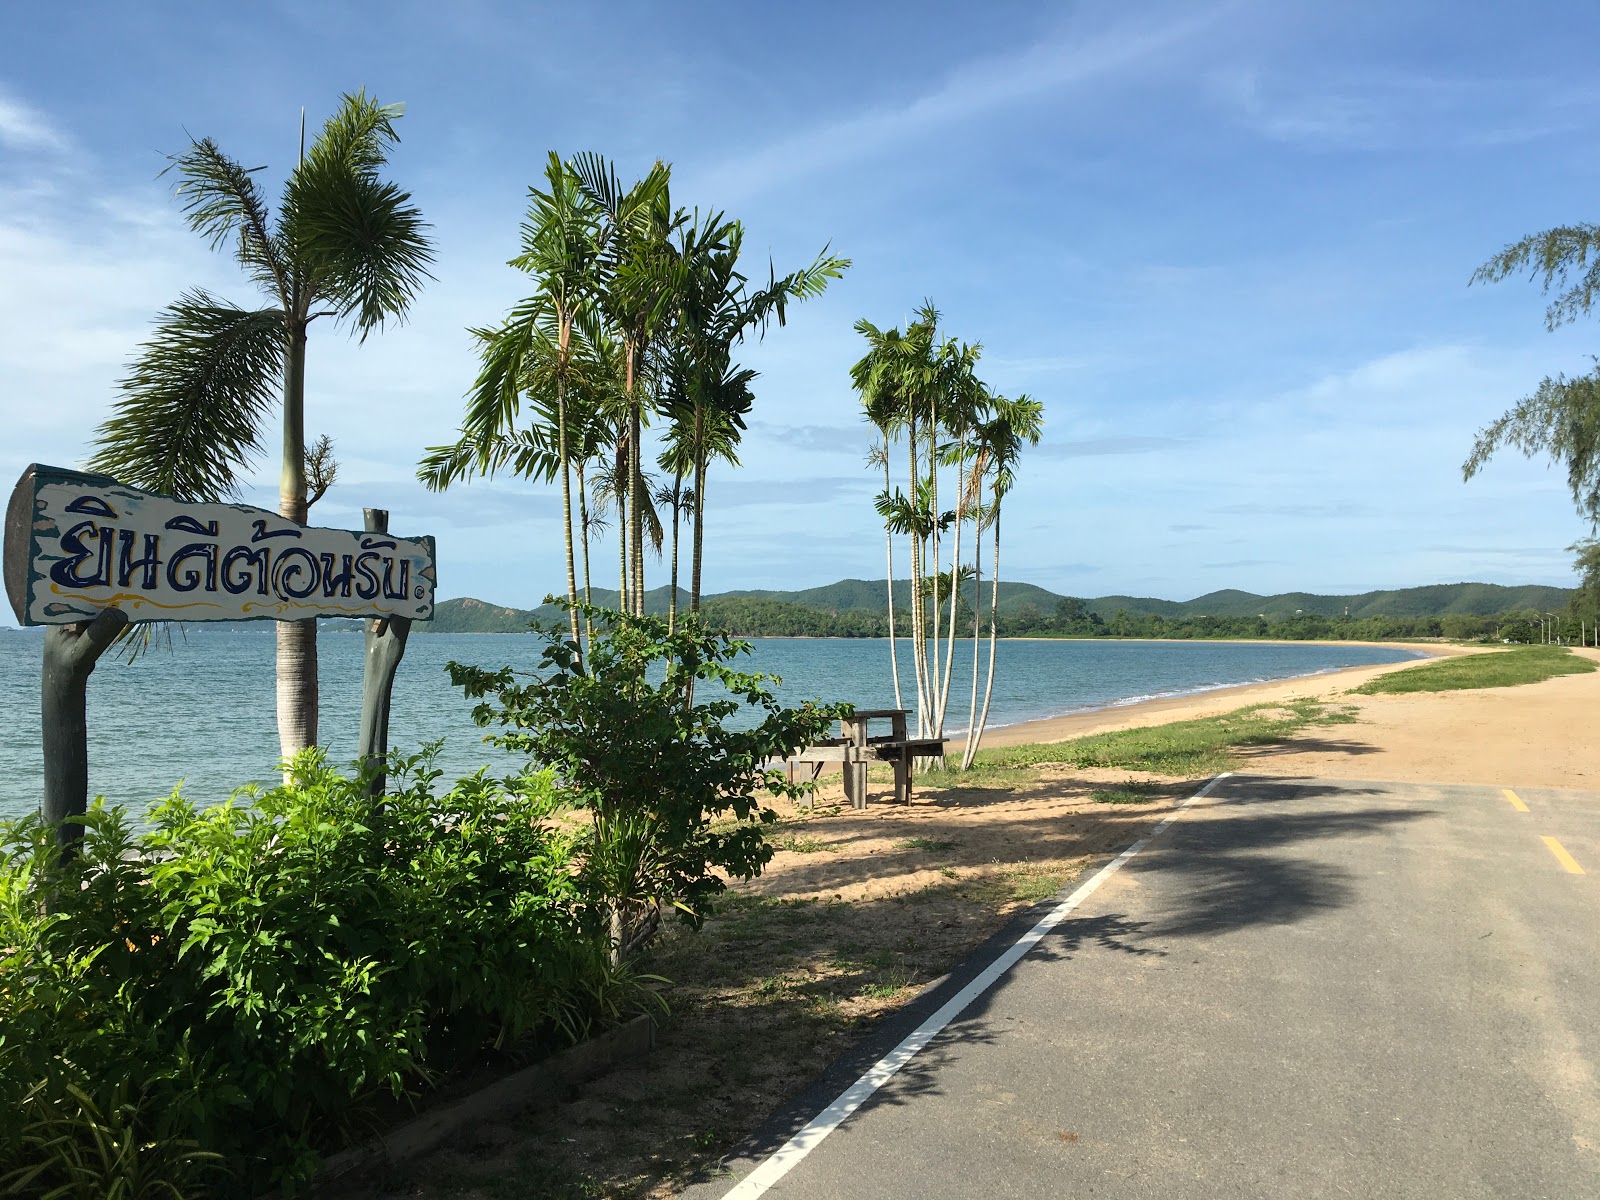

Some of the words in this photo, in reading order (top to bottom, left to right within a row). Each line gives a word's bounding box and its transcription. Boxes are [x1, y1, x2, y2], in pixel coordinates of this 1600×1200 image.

[50, 496, 409, 601] ยินดีต้อนรับ
